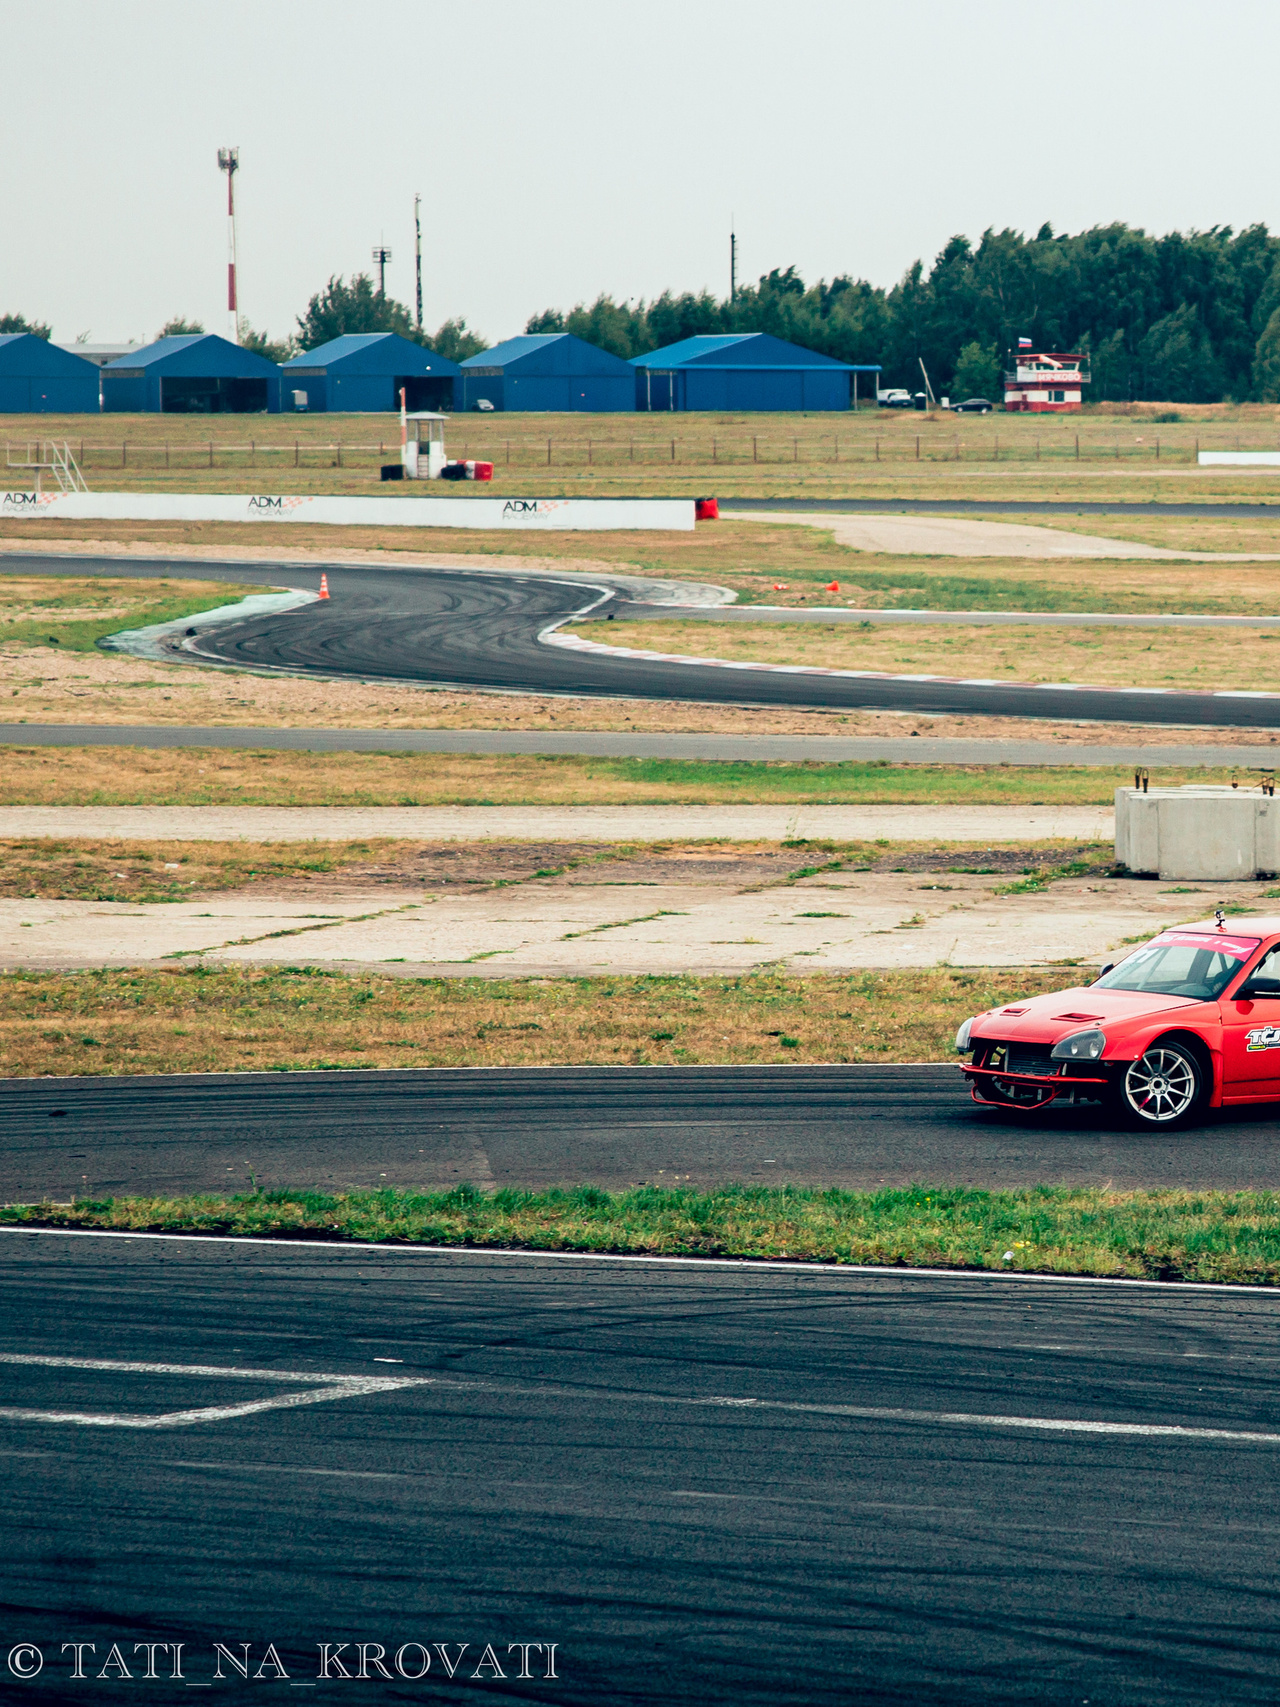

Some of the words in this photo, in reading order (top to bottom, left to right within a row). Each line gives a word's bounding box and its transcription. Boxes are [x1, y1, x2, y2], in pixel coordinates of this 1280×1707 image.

[3, 492, 37, 504] ADM
[248, 496, 282, 508] ADM
[503, 501, 537, 512] ADM
